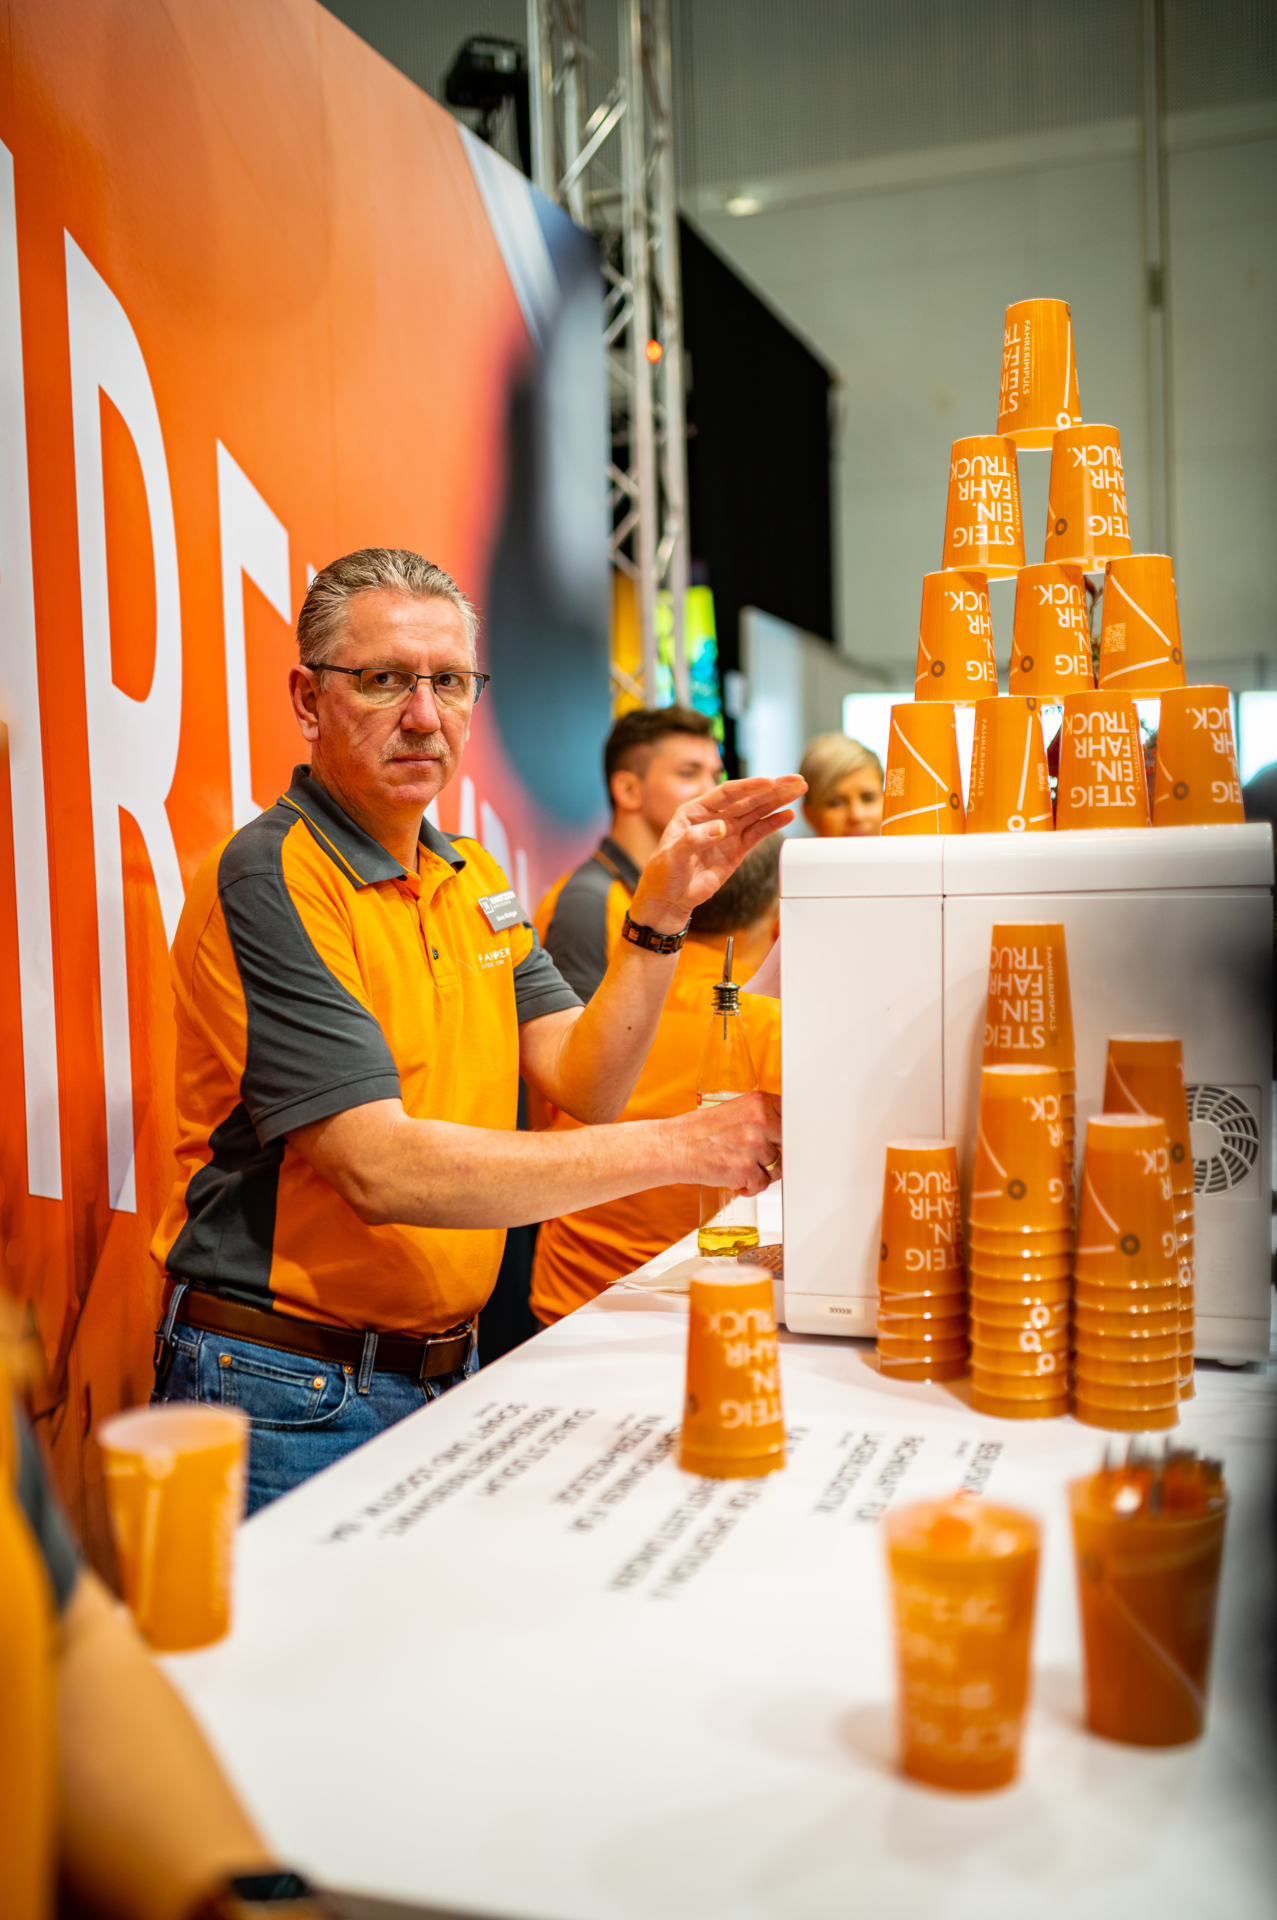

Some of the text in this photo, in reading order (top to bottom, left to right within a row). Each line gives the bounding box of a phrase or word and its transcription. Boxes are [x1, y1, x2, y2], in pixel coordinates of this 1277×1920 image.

[1022, 320, 1031, 395] FAHRERIMPULS
[957, 478, 1012, 501] FAHR
[972, 501, 1014, 523] EIN.
[953, 524, 1016, 548] STEIG
[944, 591, 991, 612] UCK.
[966, 614, 993, 636] HR
[966, 660, 998, 683] EIG
[1074, 736, 1132, 759] FAHR
[1091, 760, 1134, 783] EIN.
[1070, 785, 1137, 808] STEIG
[988, 973, 1044, 997] FAHR
[998, 999, 1045, 1023] EIN.
[984, 1023, 1046, 1049] STEIG
[1023, 1094, 1062, 1122] CK.
